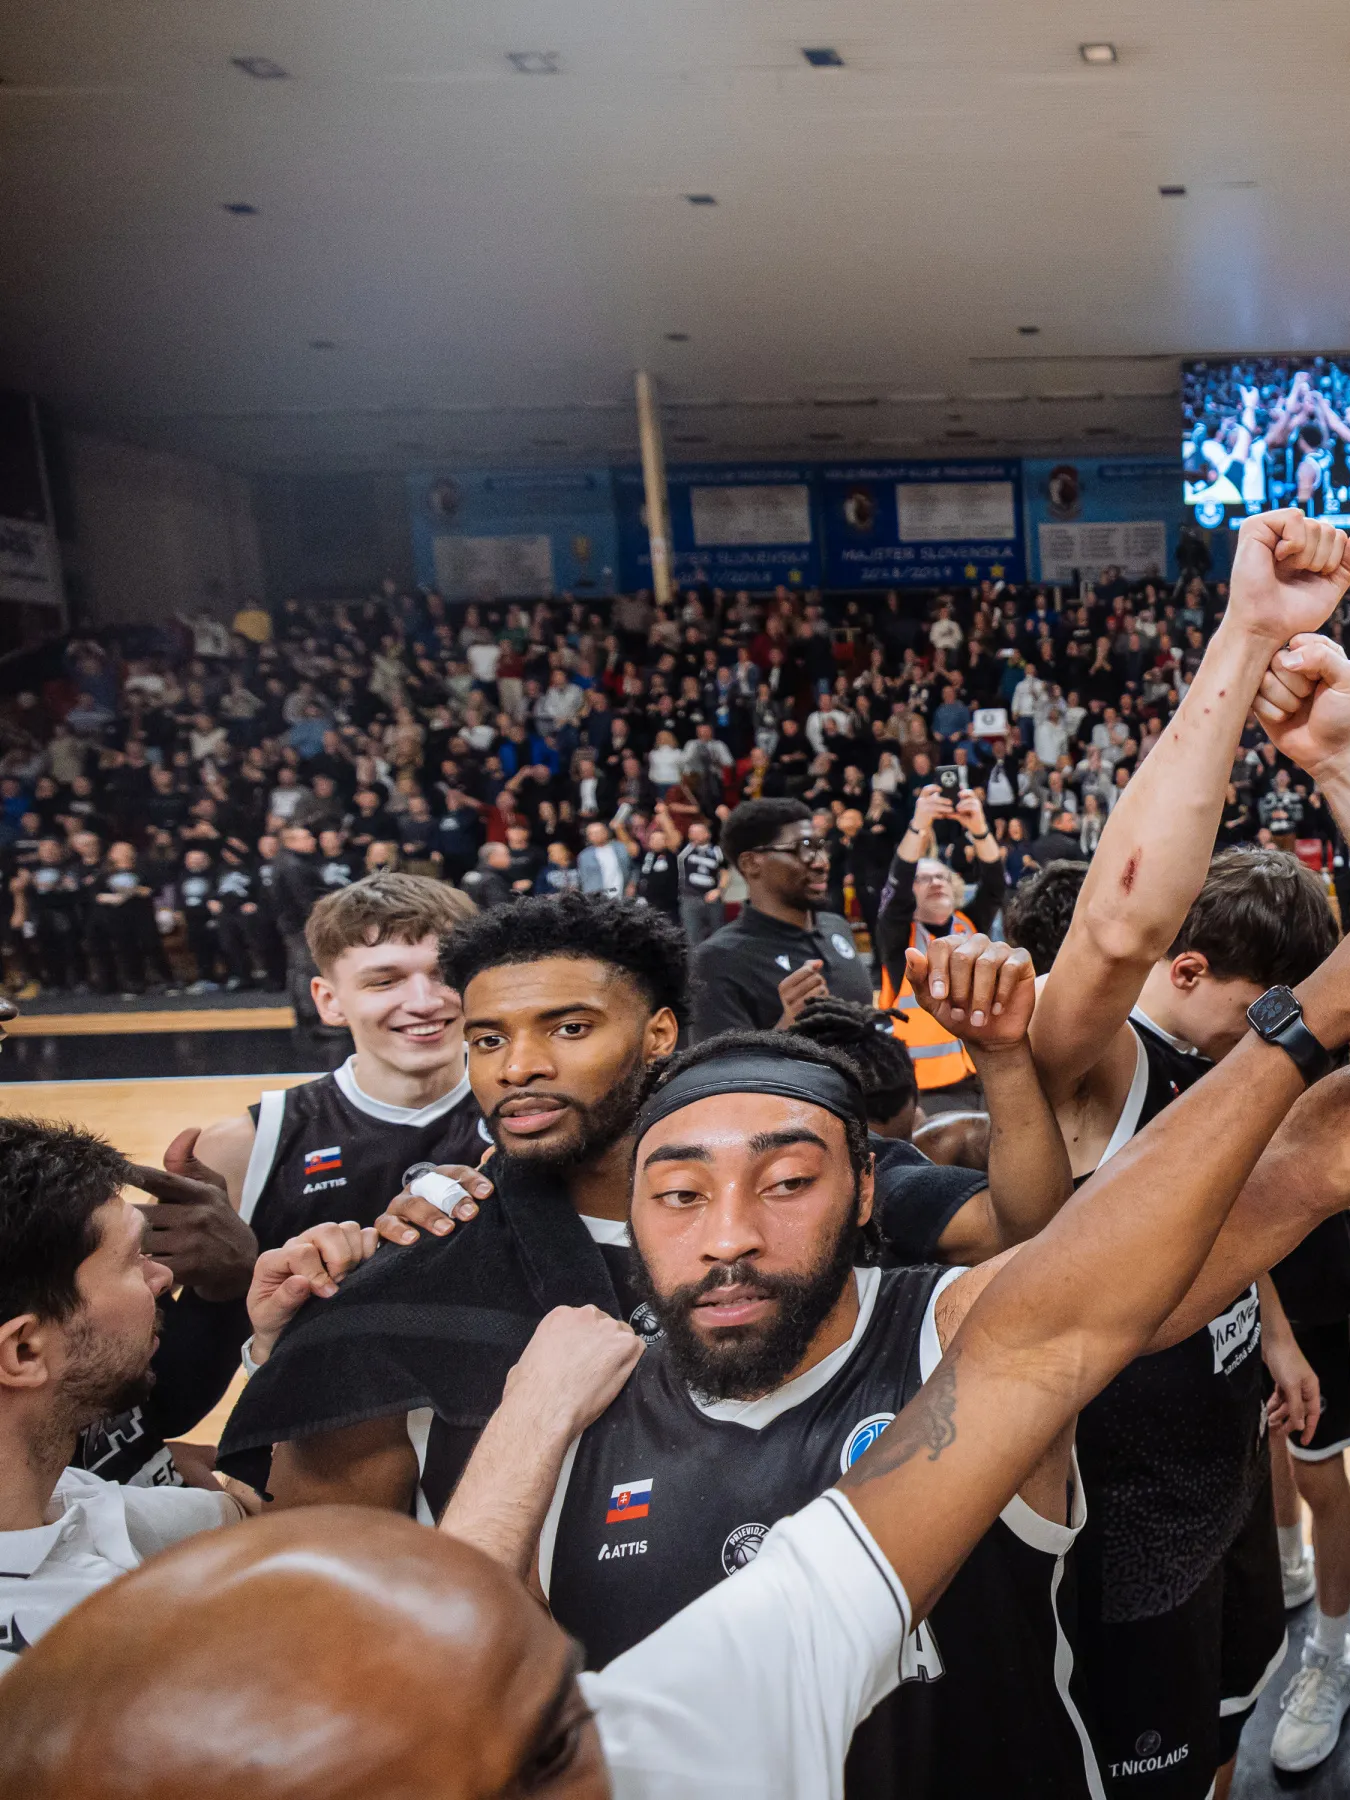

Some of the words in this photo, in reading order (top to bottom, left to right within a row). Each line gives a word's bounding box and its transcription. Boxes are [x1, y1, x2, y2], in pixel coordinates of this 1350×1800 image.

[313, 1177, 347, 1193] ATTIS
[611, 1540, 648, 1559] ATTIS
[1122, 1744, 1189, 1776] NICOLAUS
